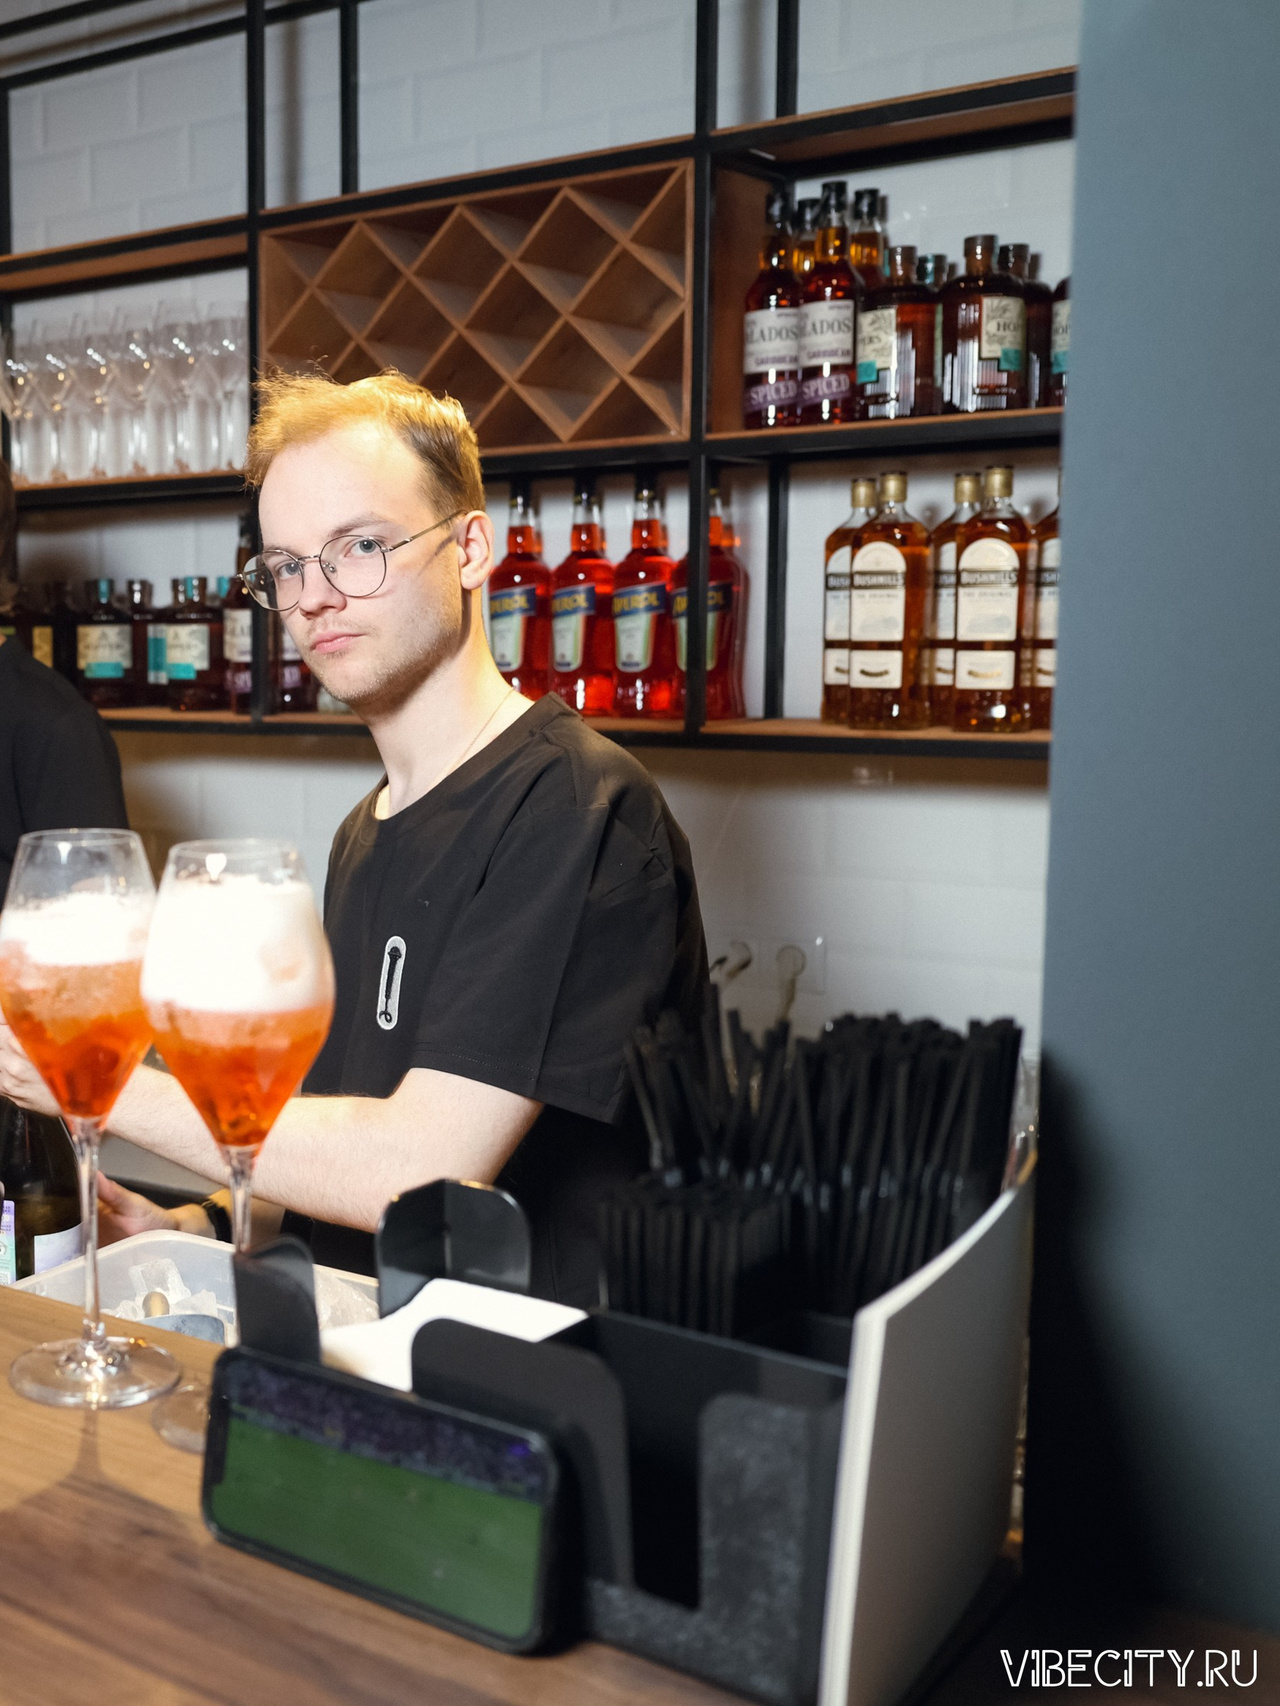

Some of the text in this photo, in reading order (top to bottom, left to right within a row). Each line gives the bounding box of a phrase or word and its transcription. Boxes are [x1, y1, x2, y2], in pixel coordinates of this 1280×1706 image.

[750, 380, 798, 405] SPICED
[803, 373, 850, 400] SPICED
[853, 572, 905, 587] BUSHMILLS
[961, 570, 1018, 585] BUSHMILLS
[613, 591, 659, 615] APEROL
